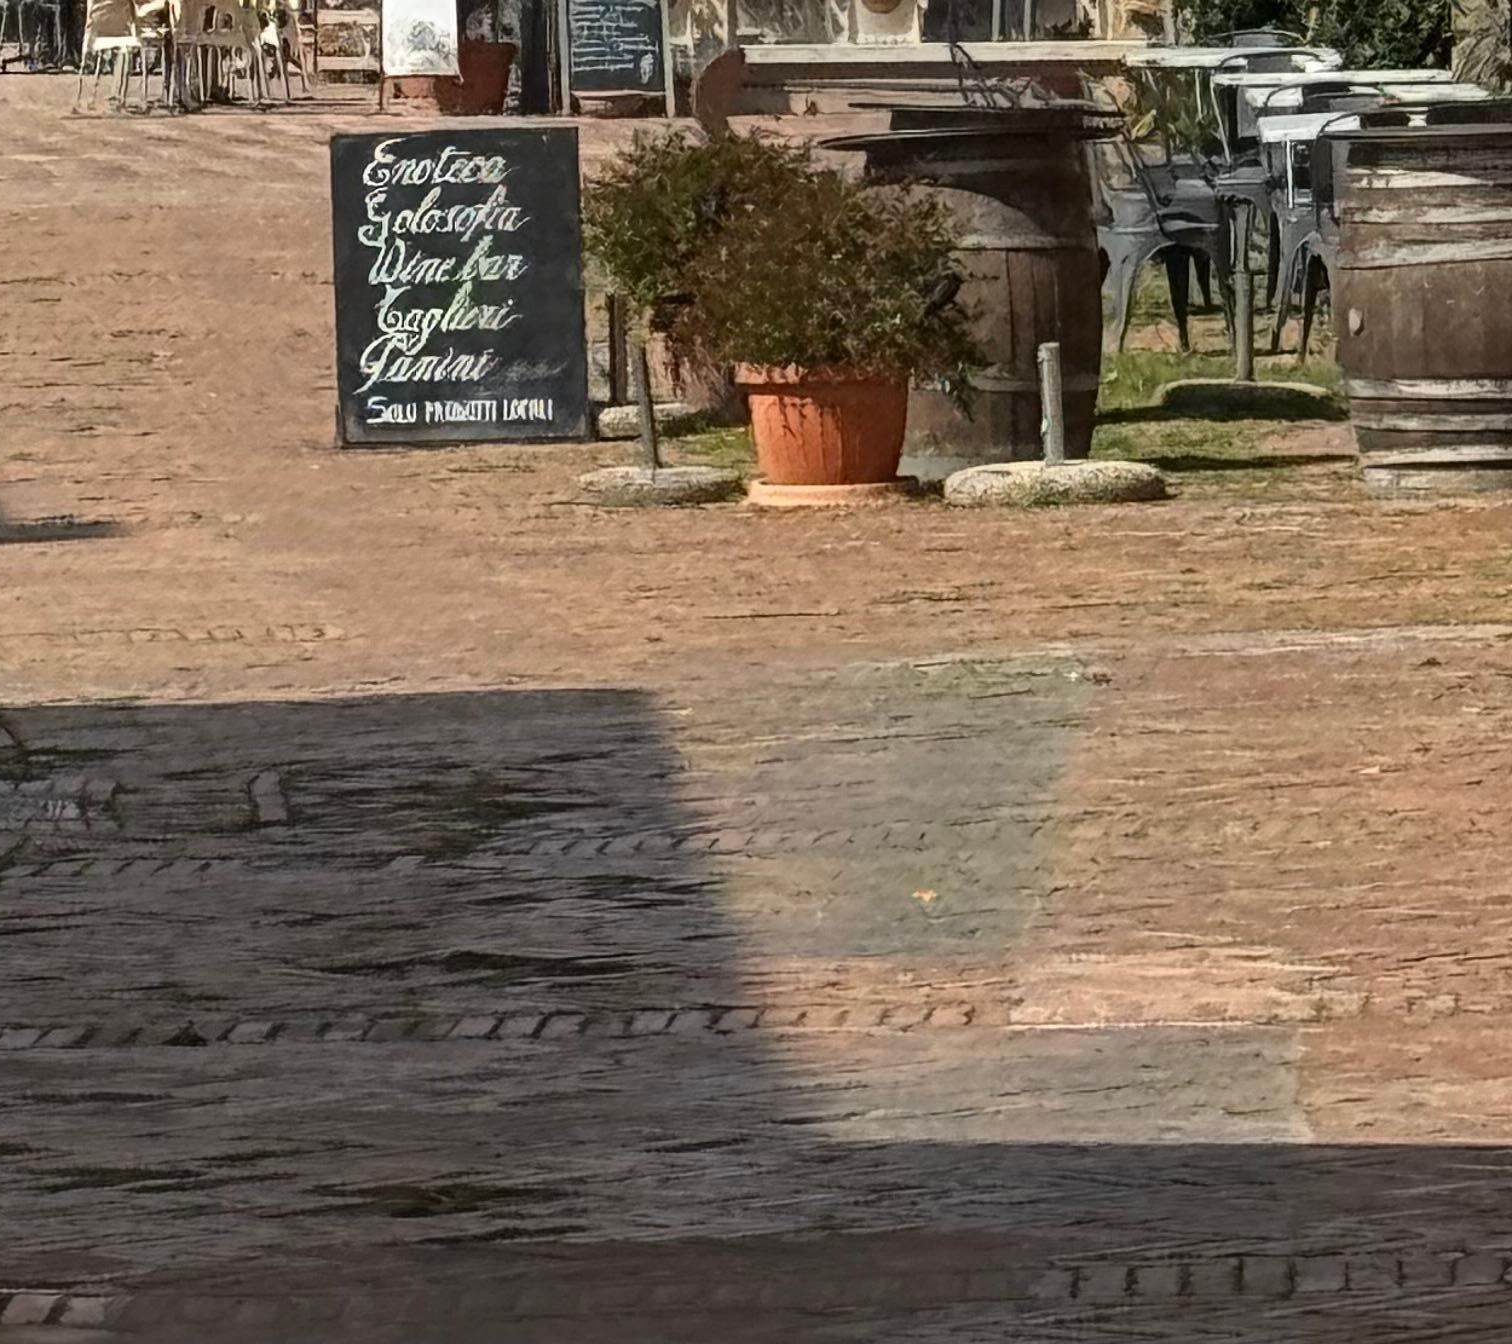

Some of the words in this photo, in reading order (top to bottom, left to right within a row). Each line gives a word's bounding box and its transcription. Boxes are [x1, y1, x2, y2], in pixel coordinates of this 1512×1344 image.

[362, 137, 516, 187] Enoteca
[367, 236, 457, 286] Wine
[457, 234, 529, 281] bar
[352, 332, 503, 395] Panini
